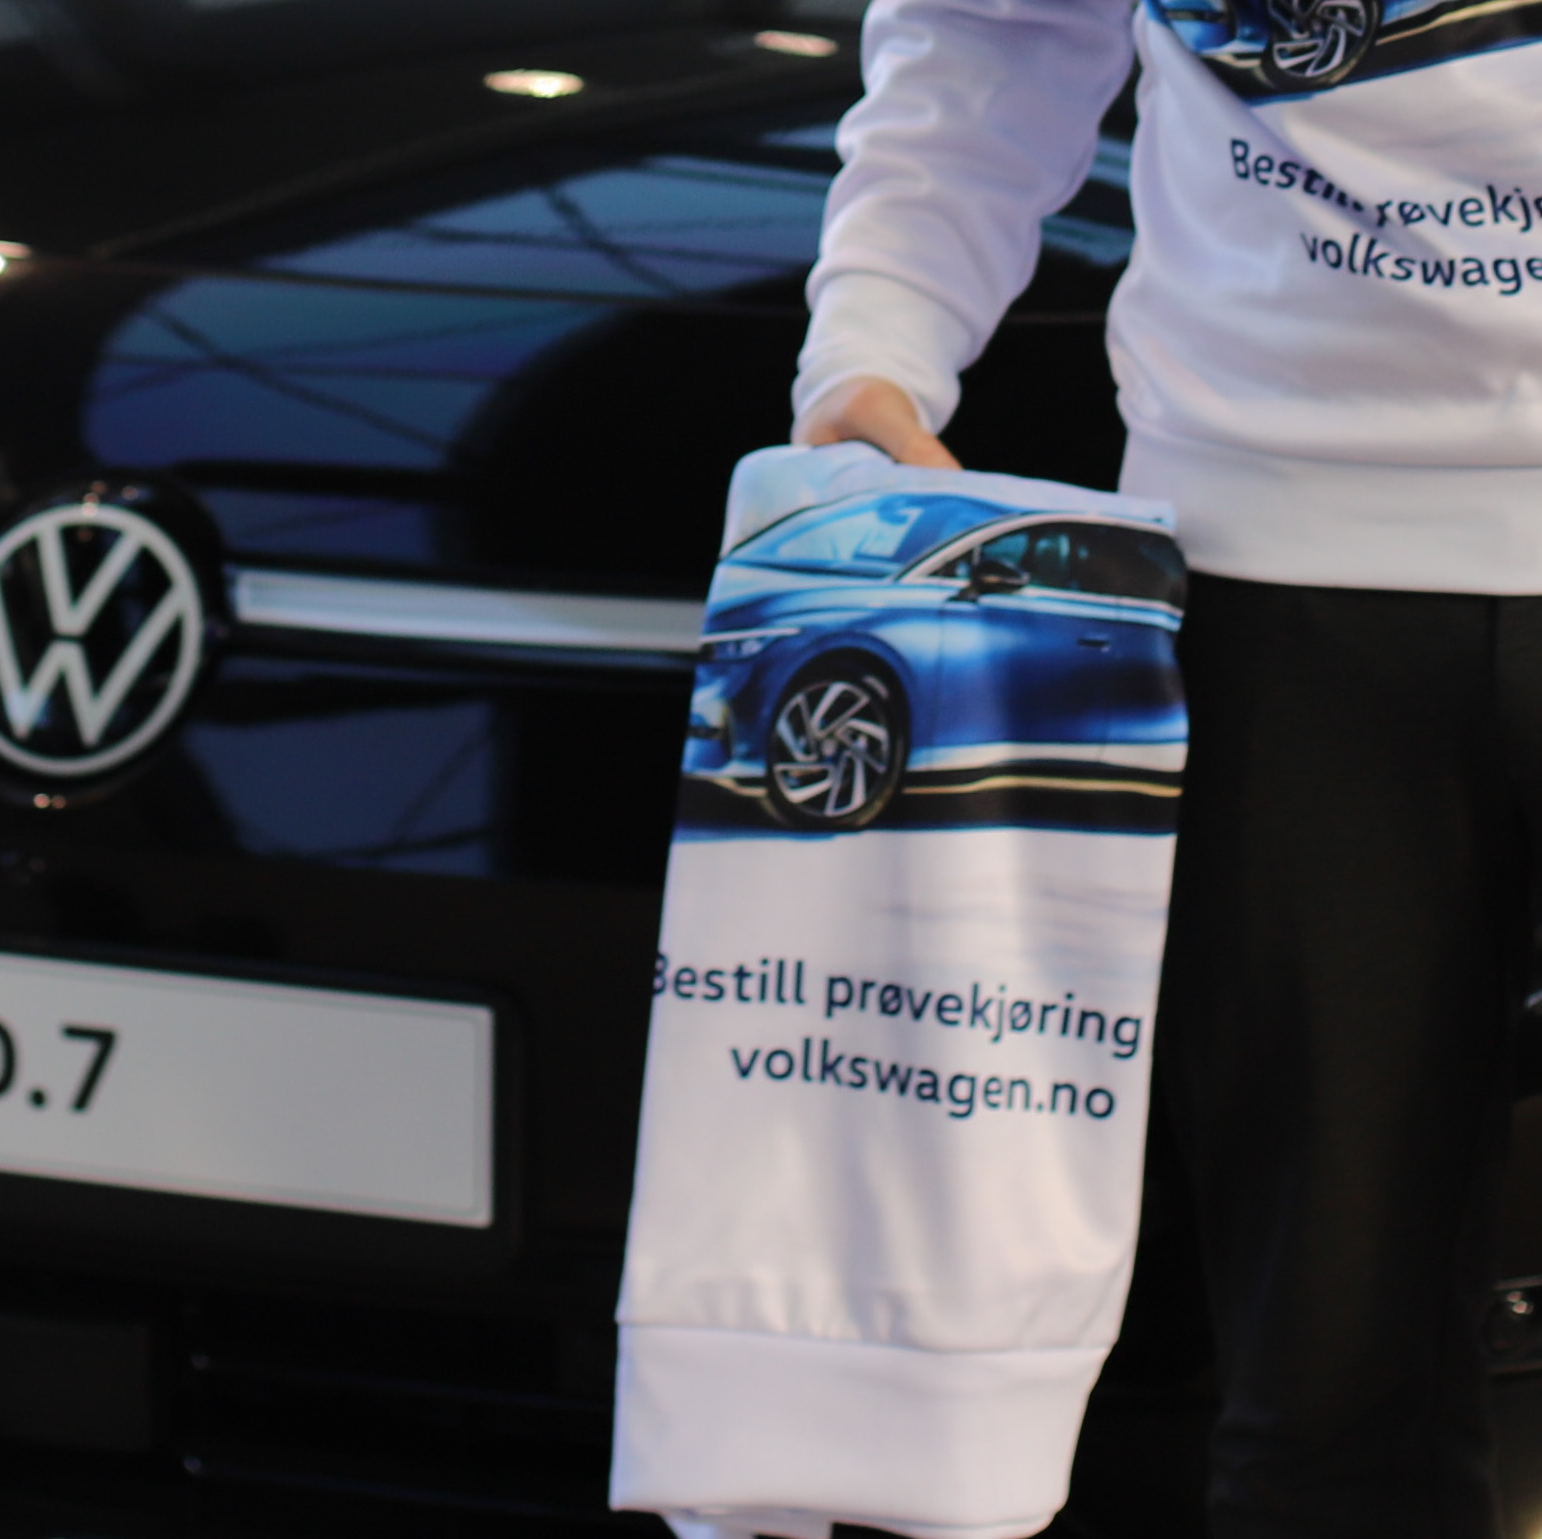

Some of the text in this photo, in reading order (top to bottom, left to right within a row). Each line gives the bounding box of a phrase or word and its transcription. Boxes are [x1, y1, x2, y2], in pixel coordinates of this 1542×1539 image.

[652, 951, 1144, 1061] Bestill prøvekjøring
[728, 1034, 1119, 1122] volkswagen.no
